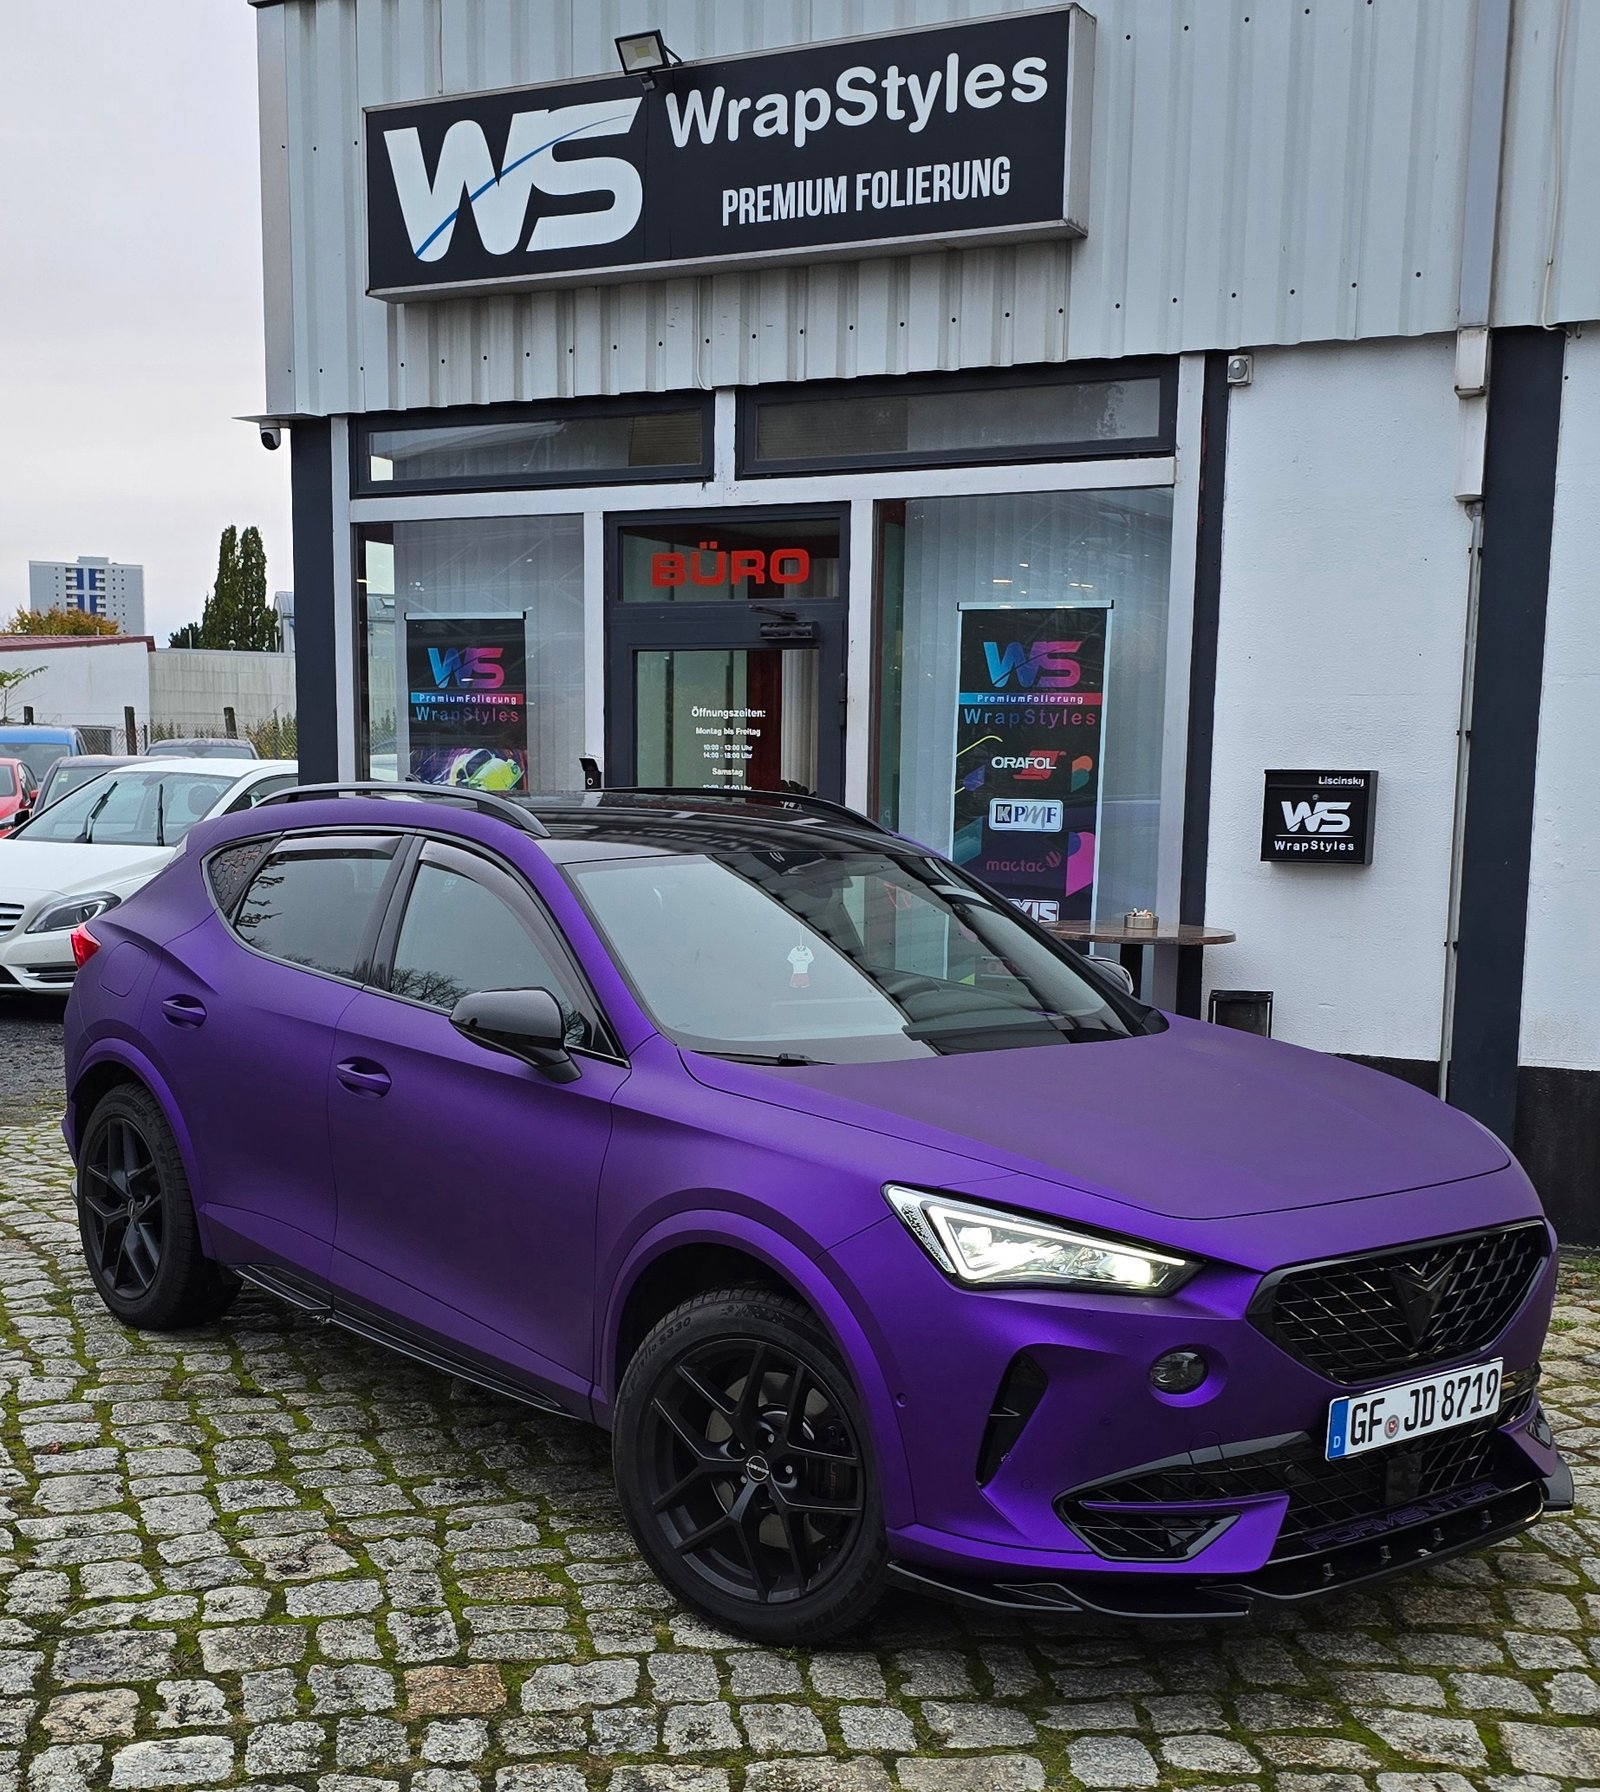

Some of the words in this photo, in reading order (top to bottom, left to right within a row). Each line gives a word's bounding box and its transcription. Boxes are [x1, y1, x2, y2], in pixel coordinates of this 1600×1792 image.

[665, 52, 1048, 148] WrapStyles
[383, 96, 643, 262] WS
[722, 175, 848, 226] PREMIUM
[855, 156, 1011, 211] FOLIERUNG
[651, 541, 810, 588] BÜRO
[427, 647, 505, 689] WS
[983, 641, 1082, 688] WS
[419, 694, 517, 706] PremiumFolierung
[977, 694, 1084, 705] PremiumFolierung
[415, 706, 519, 726] WrapStyles
[691, 706, 766, 719] Öffnungszeiten:
[964, 708, 1097, 729] WrapStyles
[696, 727, 722, 736] Montag
[723, 727, 735, 735] bis
[736, 728, 761, 737] Freitag
[712, 767, 743, 777] Samstag
[991, 756, 1057, 769] ORAFOL
[995, 804, 1058, 828] KPMF
[1281, 801, 1351, 833] WS
[1274, 841, 1355, 852] WrapStyles
[986, 860, 1046, 873] mactac
[1333, 1435, 1341, 1449] D
[1350, 1398, 1386, 1446] GF
[1404, 1385, 1436, 1432] JD
[1441, 1368, 1499, 1421] 8719
[1302, 1481, 1504, 1550] FORMENTOR
